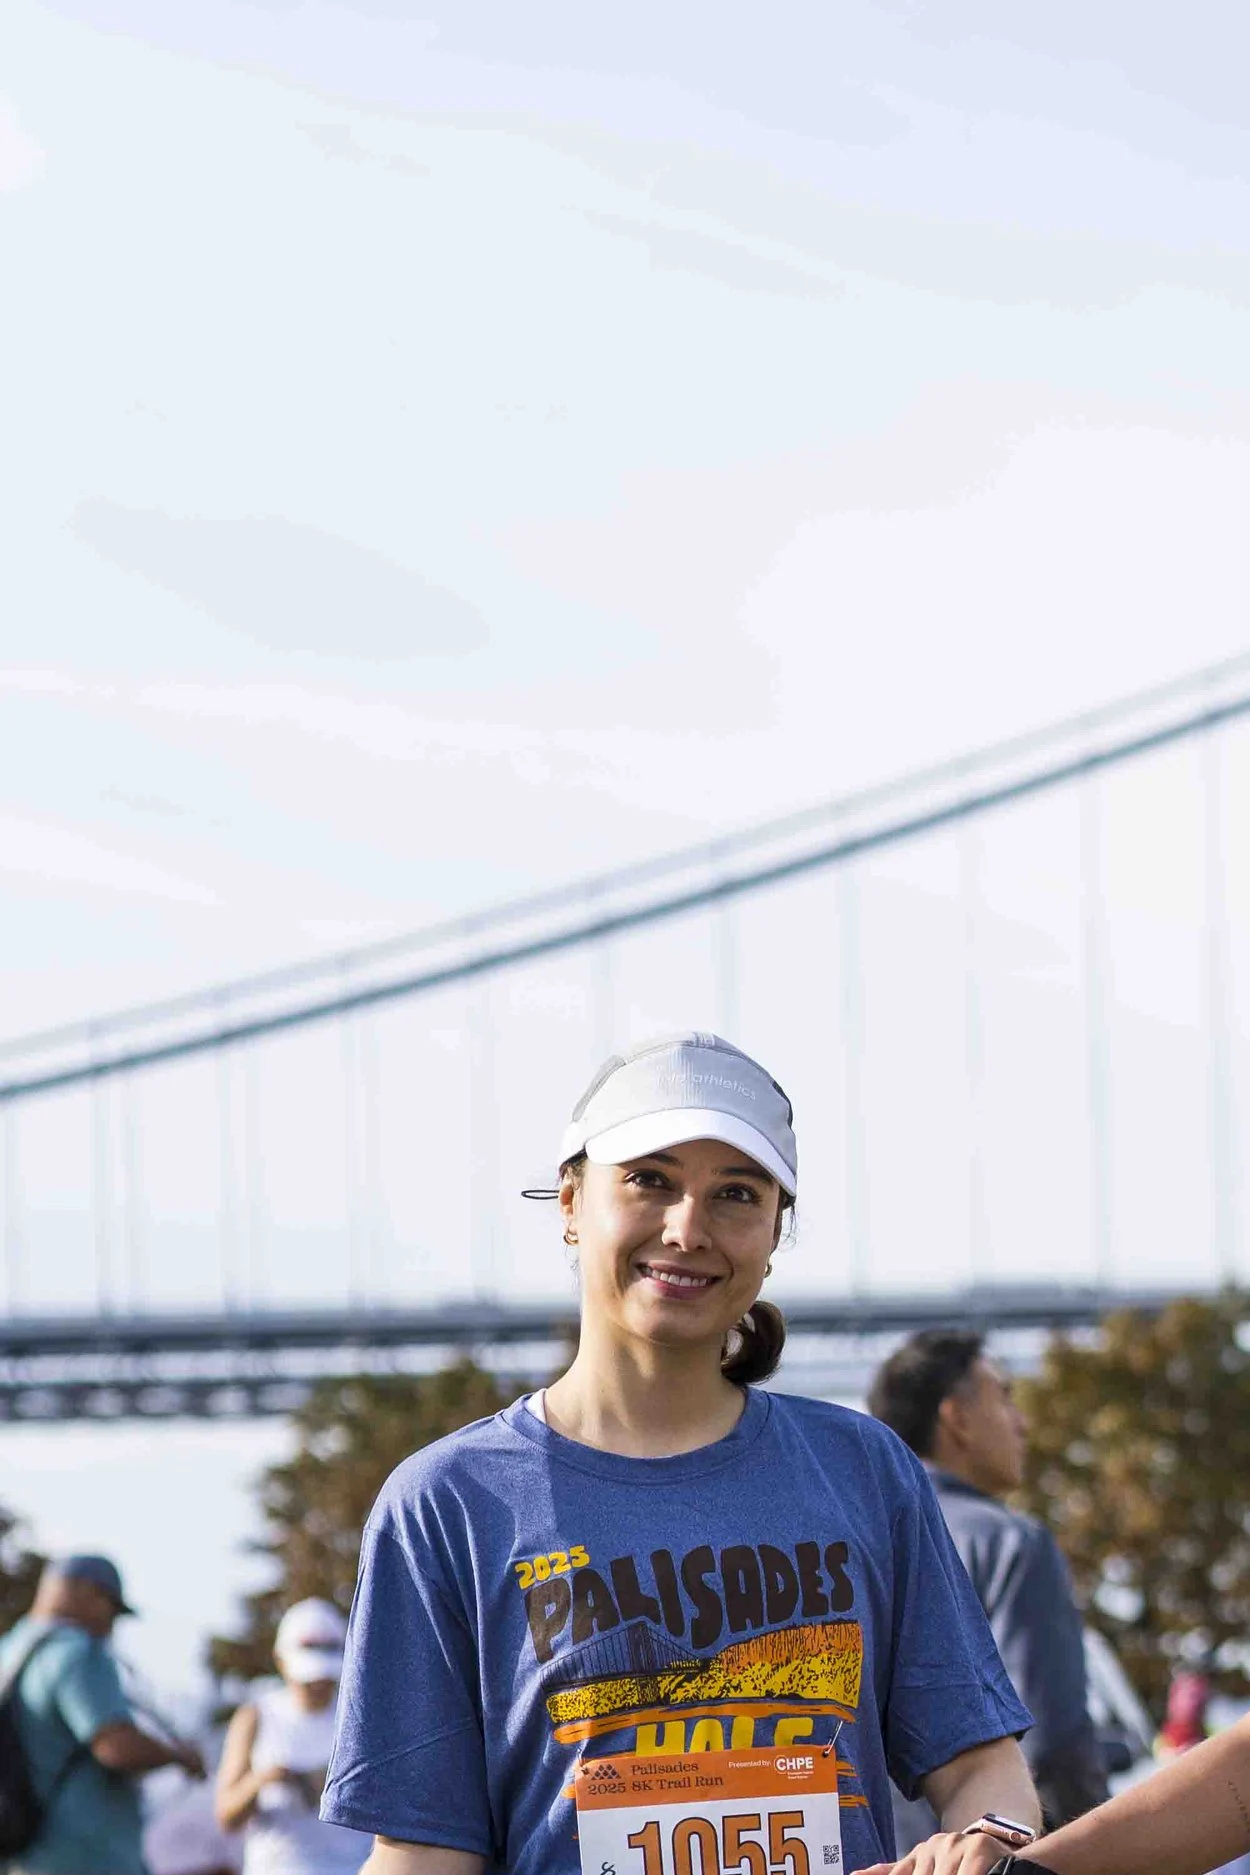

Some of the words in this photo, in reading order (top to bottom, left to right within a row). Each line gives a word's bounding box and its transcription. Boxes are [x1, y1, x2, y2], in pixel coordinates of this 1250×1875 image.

[515, 1545, 591, 1590] 2025
[524, 1541, 855, 1664] PALISADES
[631, 1763, 699, 1776] Palisades
[728, 1760, 761, 1768] Presented
[775, 1756, 814, 1771] CHPE
[588, 1781, 626, 1795] 2025
[632, 1779, 654, 1792] 8K
[656, 1778, 691, 1790] Trail
[695, 1776, 723, 1787] Run
